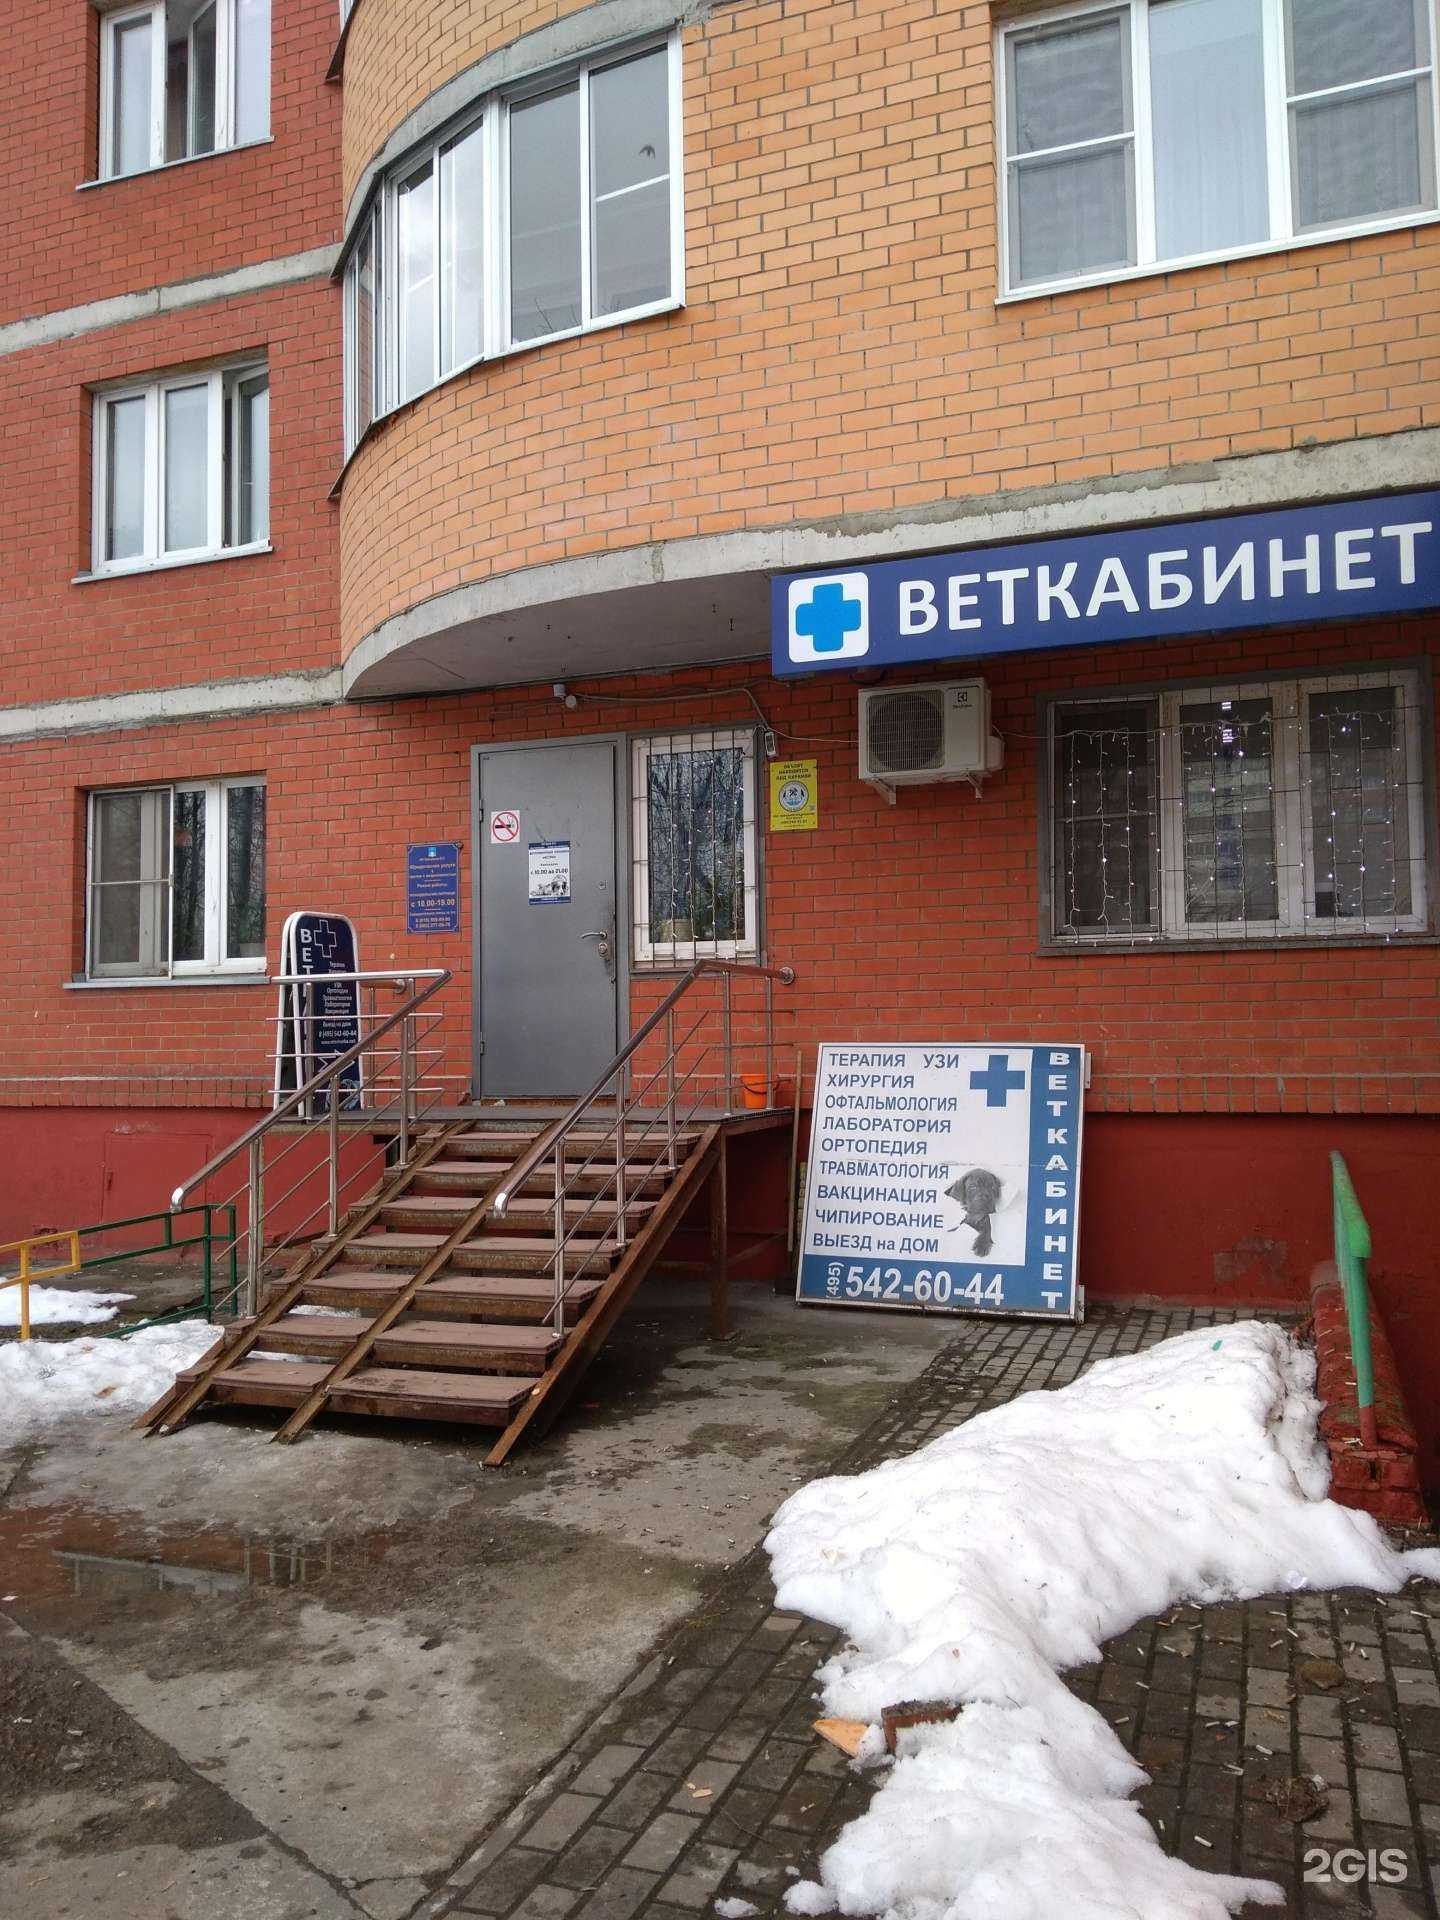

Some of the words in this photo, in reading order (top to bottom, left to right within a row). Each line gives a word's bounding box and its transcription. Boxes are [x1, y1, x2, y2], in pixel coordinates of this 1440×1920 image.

[899, 521, 1433, 635] ВЕТКАБИНЕТ
[829, 1053, 906, 1067] ТЕРАПИЯ
[923, 1054, 960, 1069] УЗИ
[827, 1074, 915, 1089] ХИРУРГИЯ
[825, 1094, 957, 1112] ОФТАЛЬМОЛОГИЯ
[822, 1117, 951, 1133] ЛАБОРАТОРИЯ
[821, 1138, 927, 1156] ОРТОПЕДИЯ
[820, 1160, 949, 1179] ТРАВМАТОЛОГИЯ
[1041, 1052, 1070, 1309] ВЕТКАБИНЕТ
[817, 1184, 937, 1205] ВАКЦИНАЦИЯ
[815, 1209, 944, 1228] ЧИПИРОВАНИЕ
[813, 1233, 871, 1251] ВЫЕЗД
[877, 1238, 895, 1251] на
[899, 1237, 939, 1253] ДОМ
[826, 1261, 845, 1299] (495)
[845, 1265, 1004, 1306] 542-60-44
